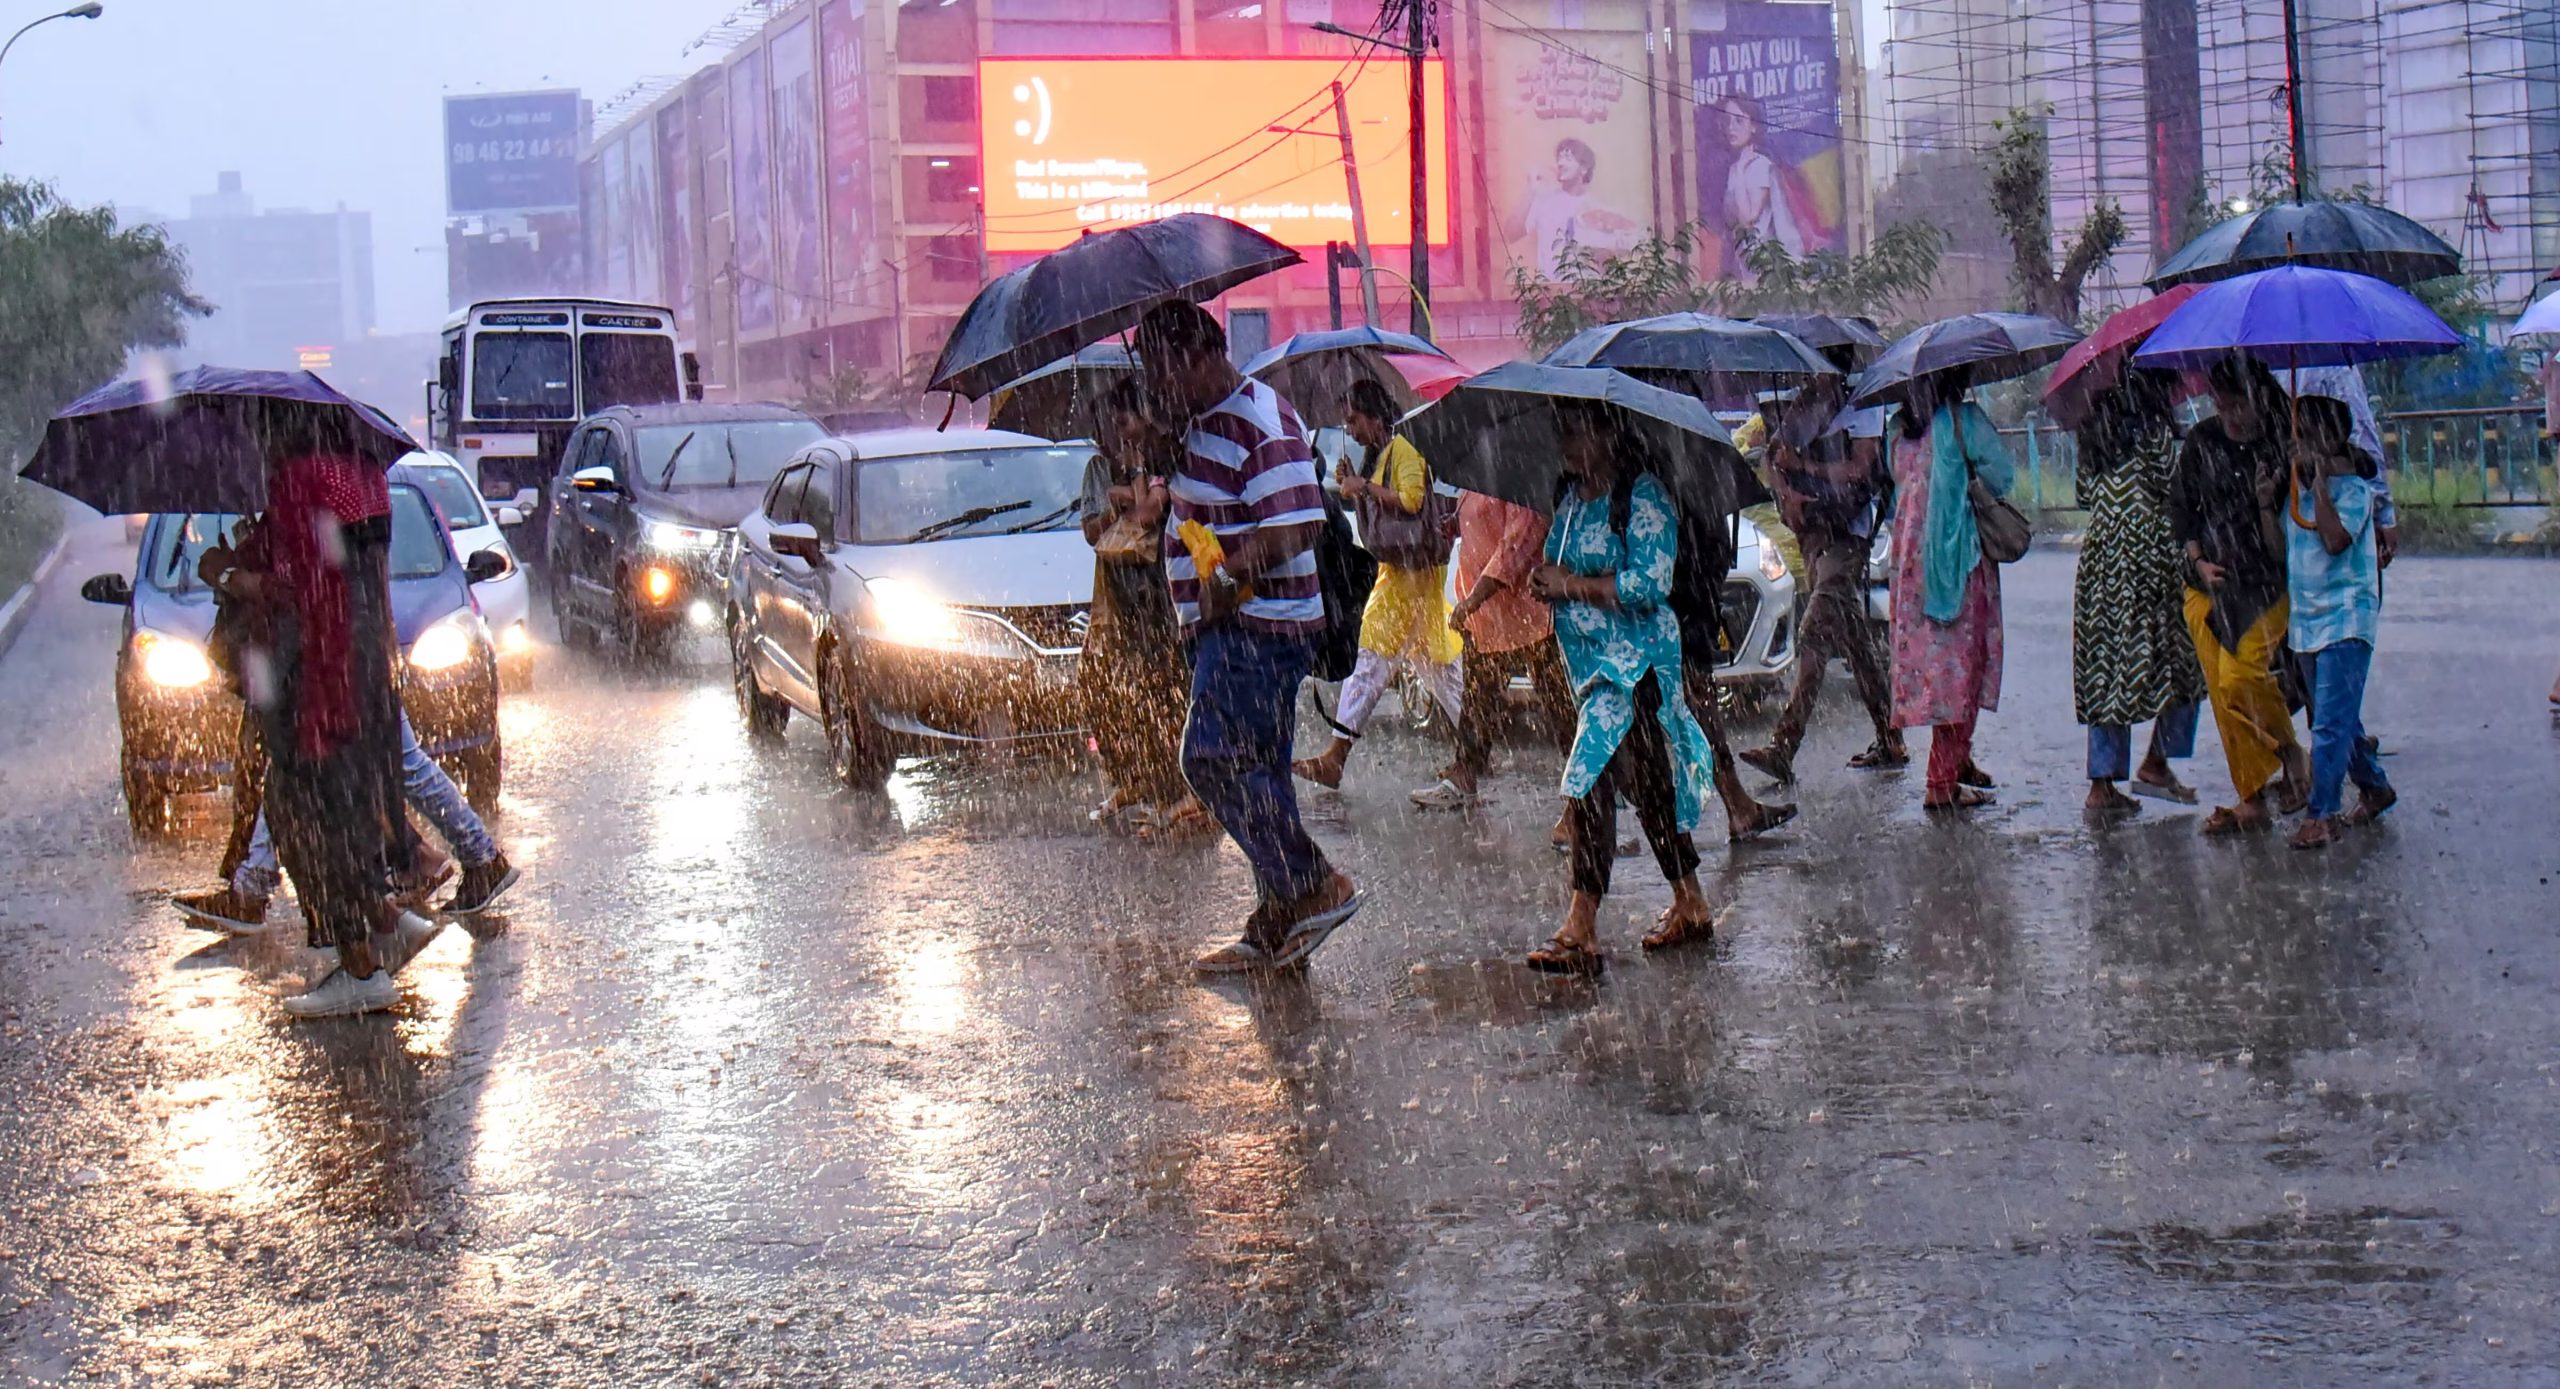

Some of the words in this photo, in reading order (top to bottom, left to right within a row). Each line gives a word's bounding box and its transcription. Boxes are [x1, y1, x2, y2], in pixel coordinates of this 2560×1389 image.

[829, 37, 861, 87] THAI
[1708, 46, 1721, 74] A
[1726, 41, 1762, 72] DAY
[1693, 75, 1728, 106] NOT
[1735, 74, 1747, 94] A
[1752, 67, 1788, 98] DAY
[1794, 61, 1826, 92] OFF
[503, 139, 525, 160] 22
[1017, 182, 1048, 198] This
[1052, 182, 1064, 198] is
[1068, 185, 1079, 198] a
[1076, 203, 1105, 221] Call
[1239, 203, 1309, 219] advertise
[496, 315, 551, 324] CONTAINER
